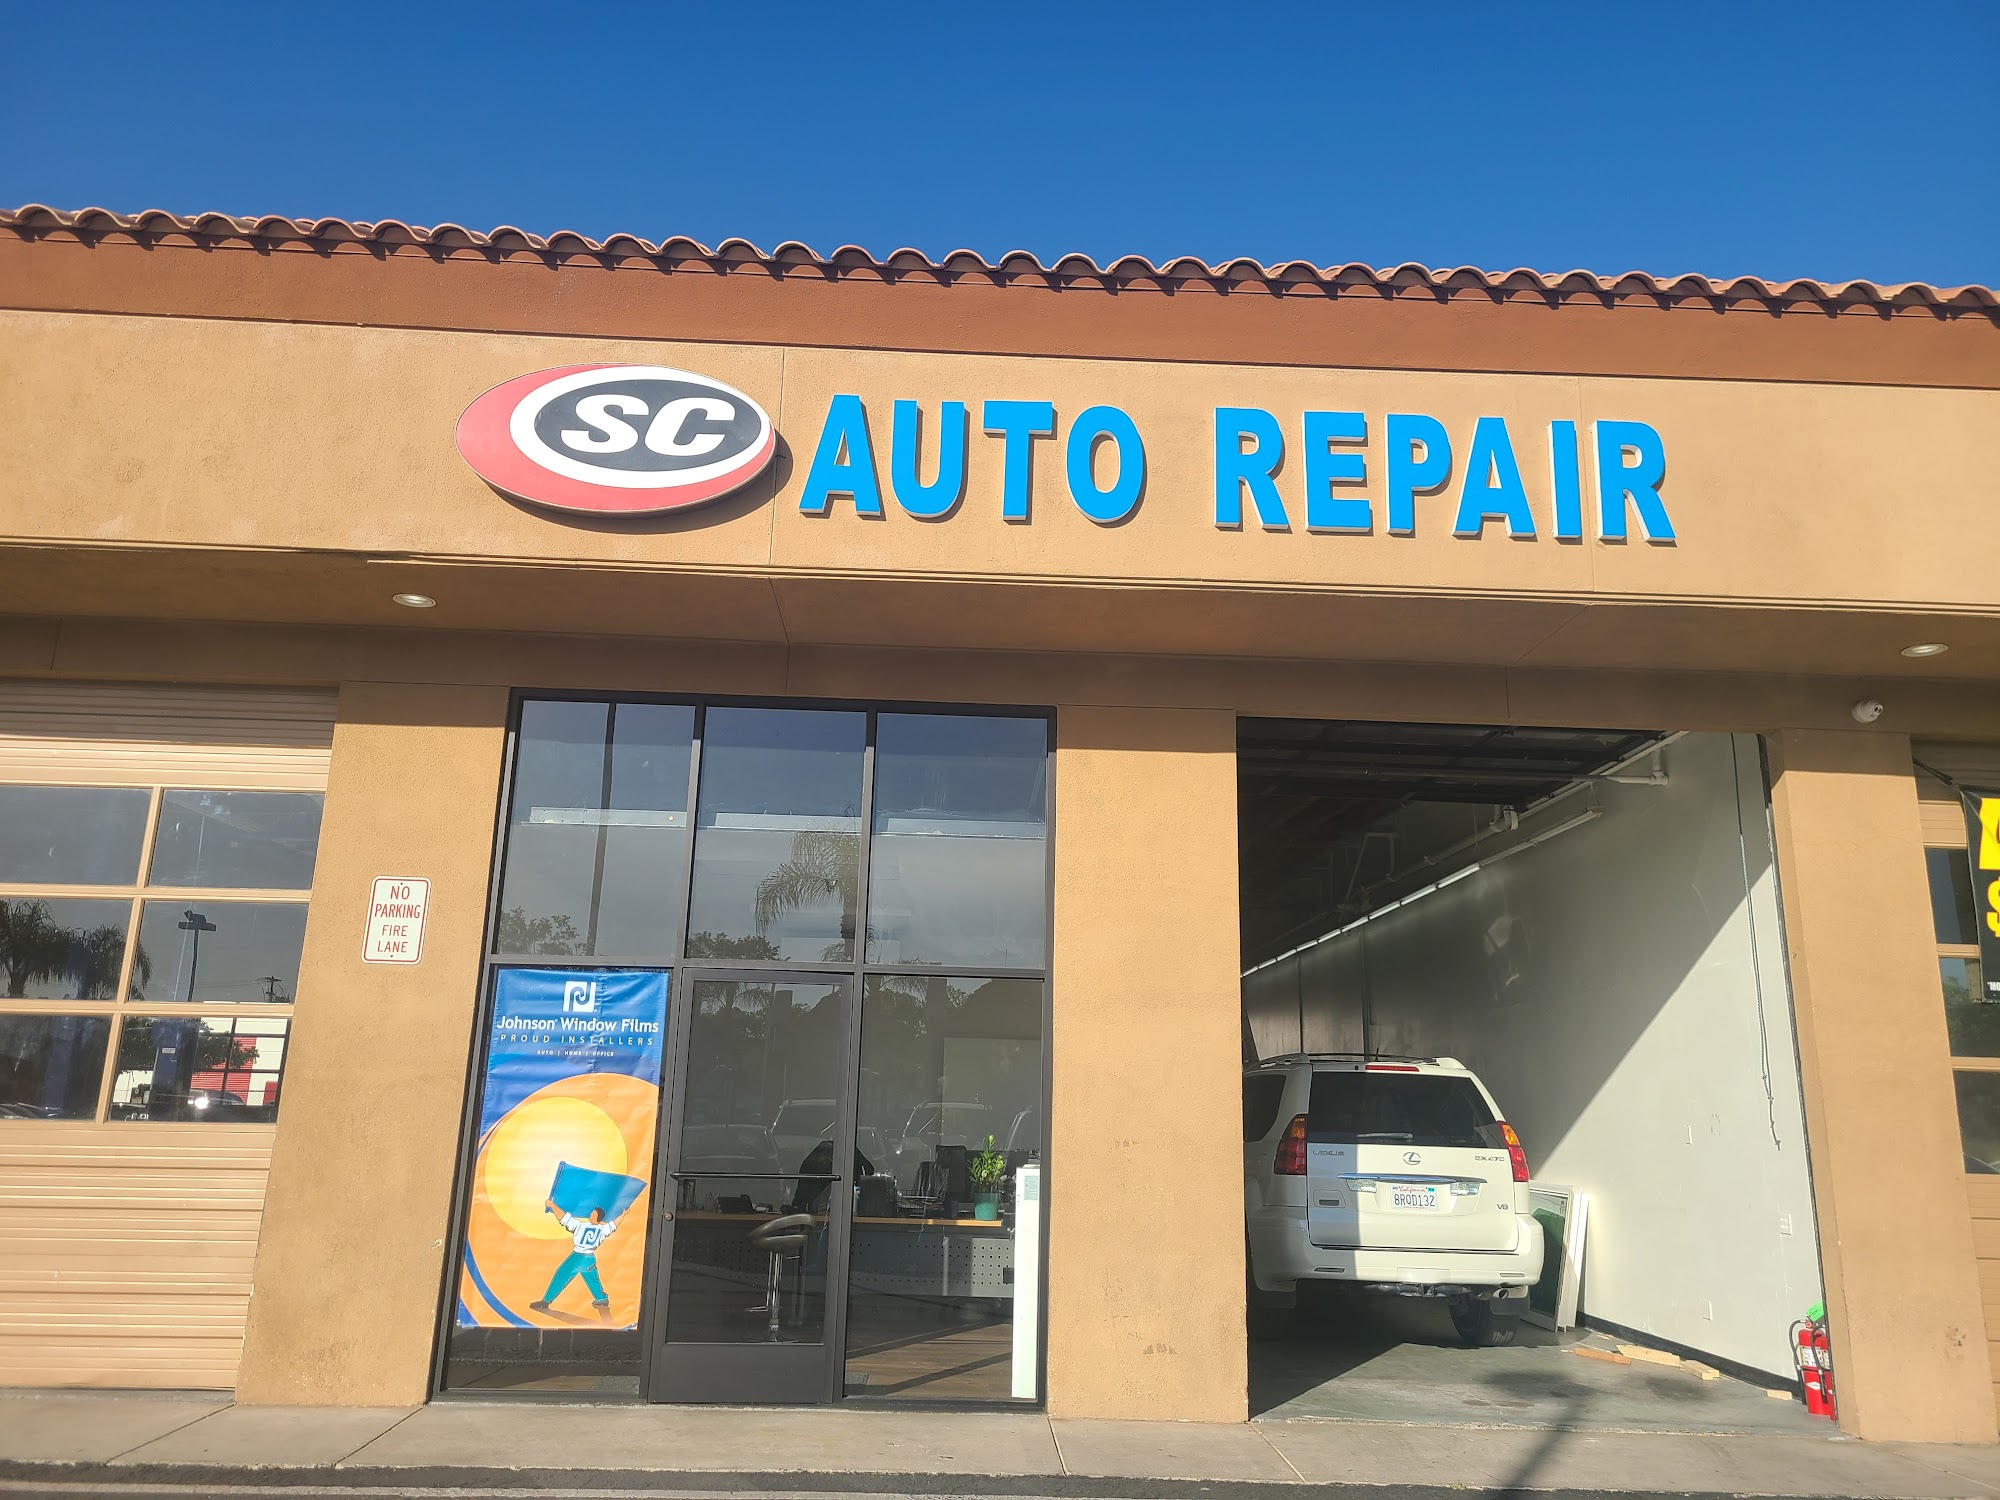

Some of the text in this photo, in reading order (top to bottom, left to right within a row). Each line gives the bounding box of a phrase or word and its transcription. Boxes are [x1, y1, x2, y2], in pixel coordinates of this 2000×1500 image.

[560, 394, 736, 458] SC
[799, 394, 1677, 544] AUTO REPAIR
[390, 885, 410, 900] NO
[374, 903, 421, 919] PARKING
[381, 924, 409, 937] FIRE
[377, 940, 409, 953] LANE
[497, 1016, 659, 1033] Johnson Window Films
[500, 1034, 653, 1046] PROUD INSTALLERS
[1393, 1193, 1436, 1207] 8RQD132
